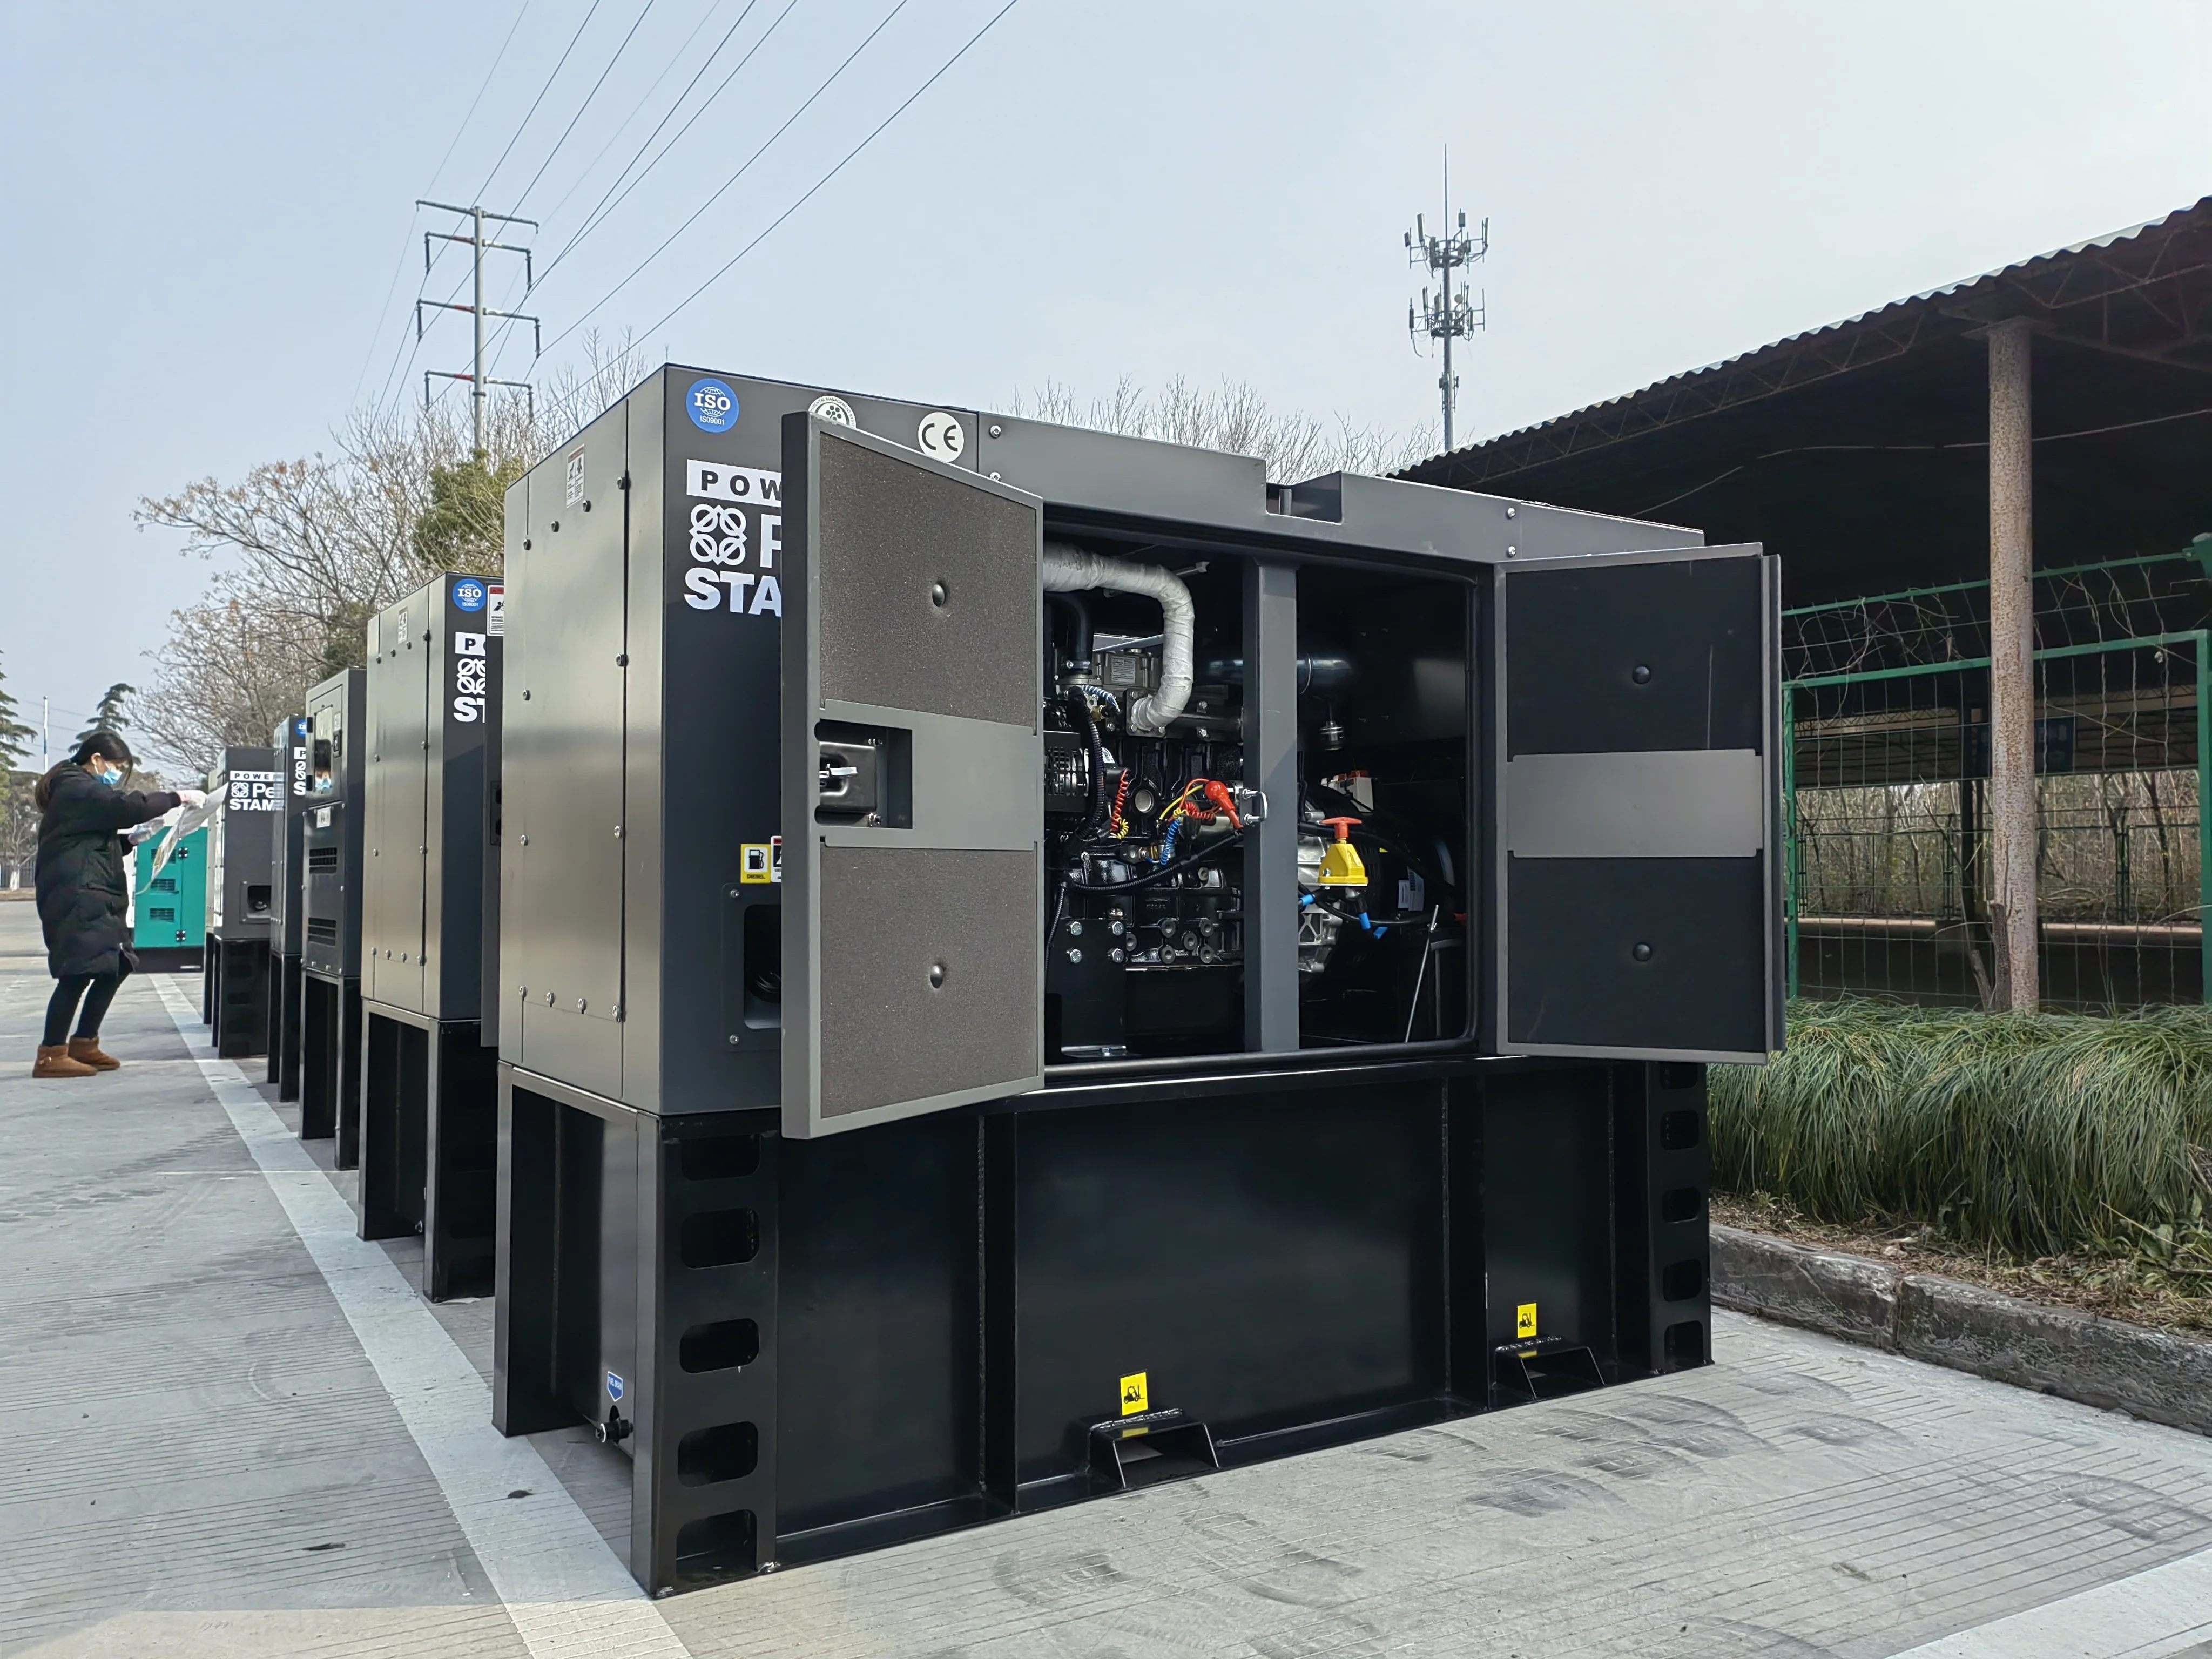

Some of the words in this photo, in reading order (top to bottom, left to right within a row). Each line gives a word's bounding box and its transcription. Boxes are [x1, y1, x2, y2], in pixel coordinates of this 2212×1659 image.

[694, 392, 731, 411] ISO
[921, 422, 958, 452] CE
[457, 588, 482, 598] ISO
